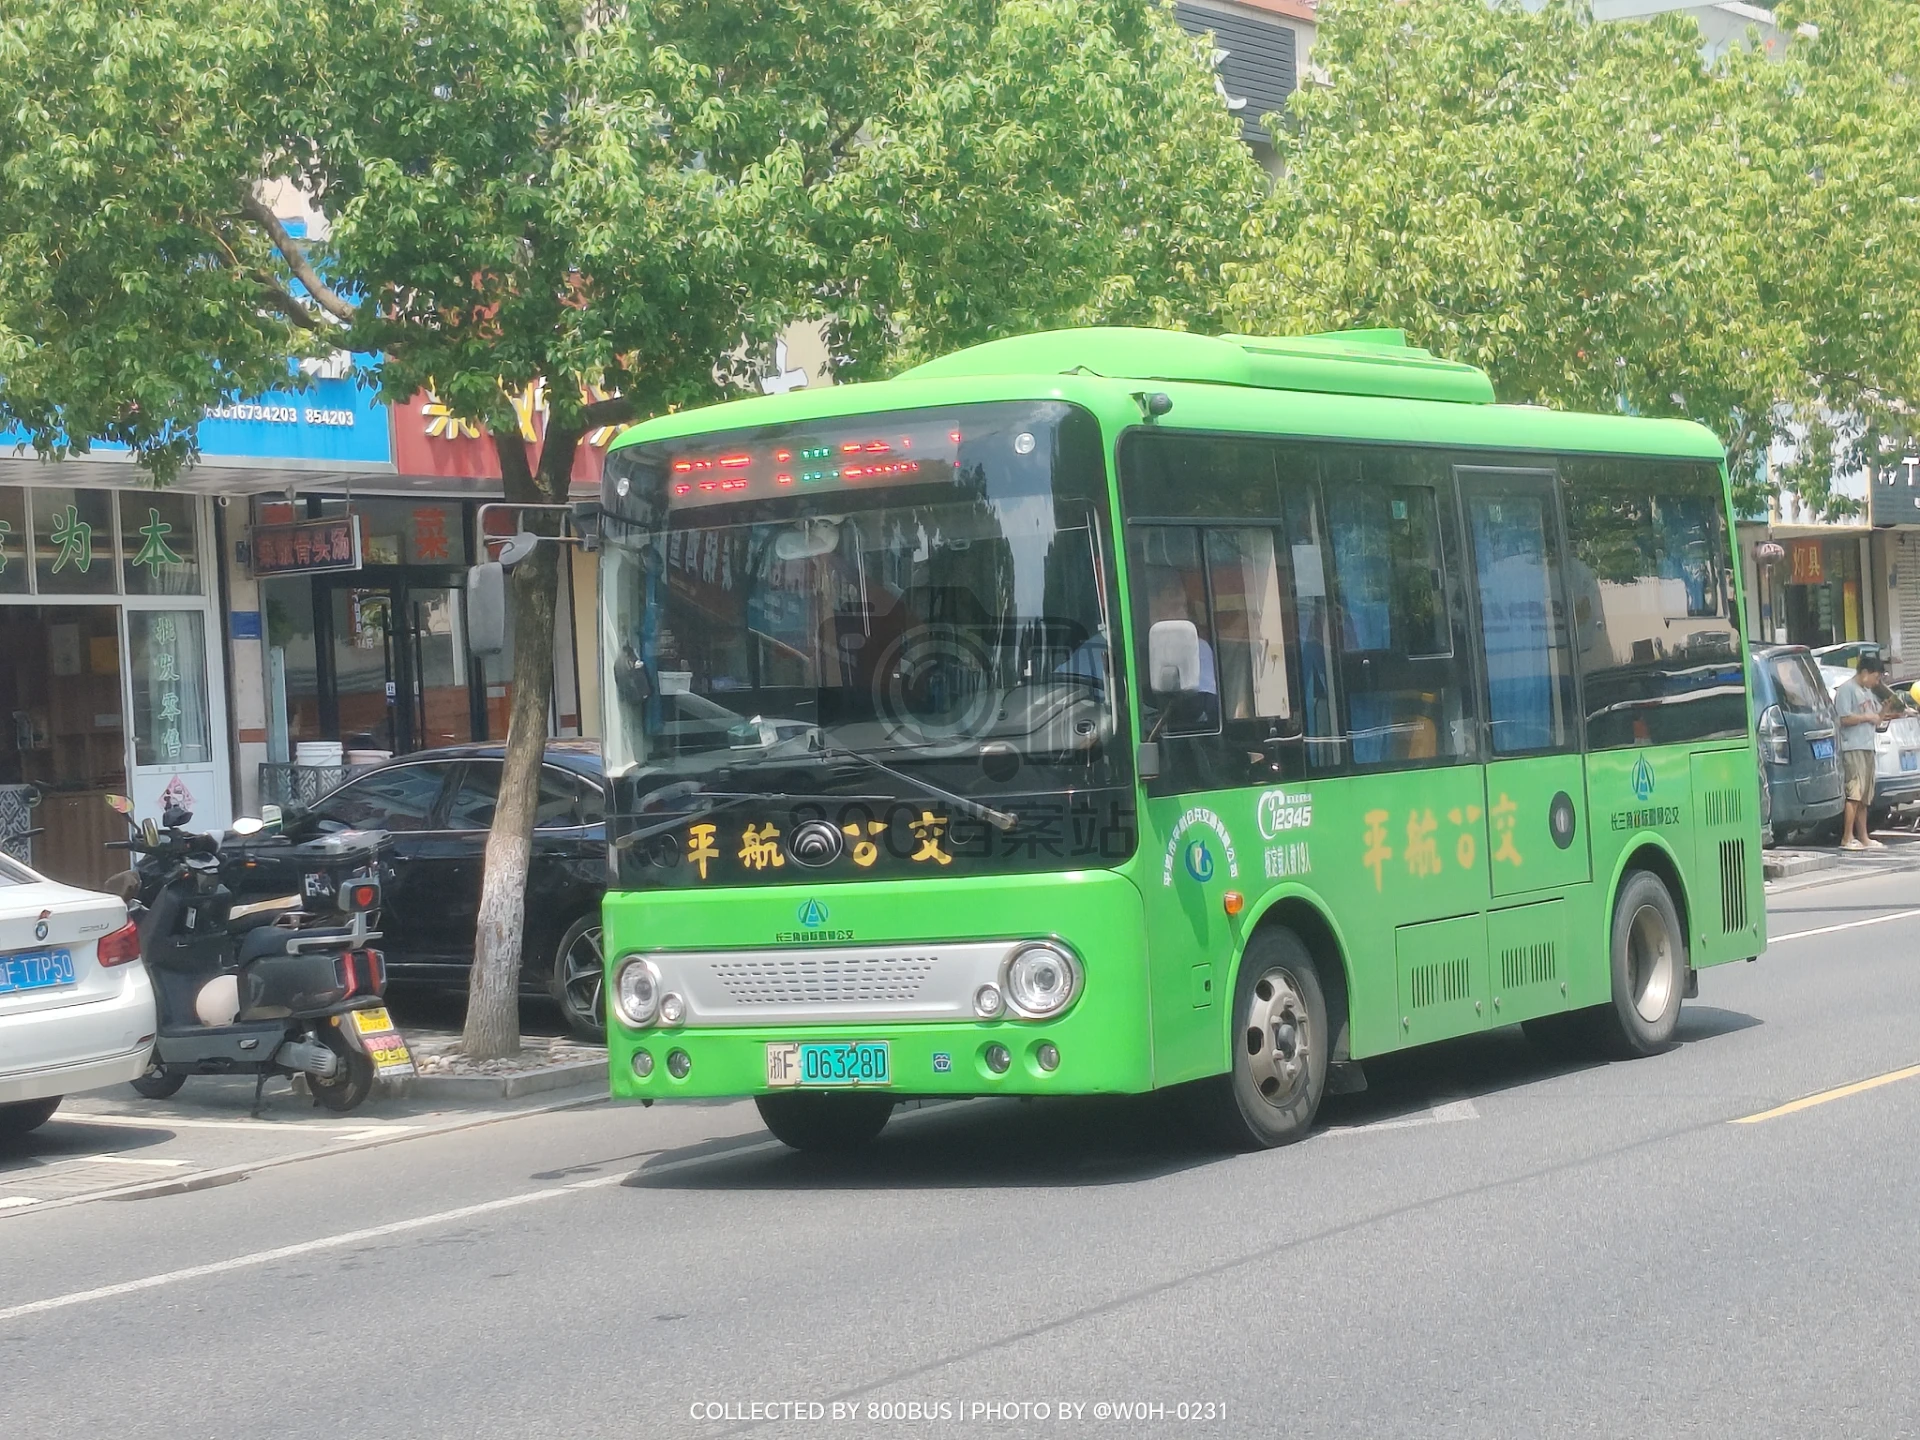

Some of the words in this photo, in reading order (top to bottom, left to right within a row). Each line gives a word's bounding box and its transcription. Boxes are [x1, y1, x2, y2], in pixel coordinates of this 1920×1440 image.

[305, 408, 354, 427] 854203
[0, 505, 184, 579] 为本
[1793, 546, 1821, 578] 灯具
[154, 616, 182, 759] 批发零售
[687, 811, 952, 879] 平航公交
[1271, 806, 1312, 831] 12345
[1363, 792, 1523, 893] 平航公交
